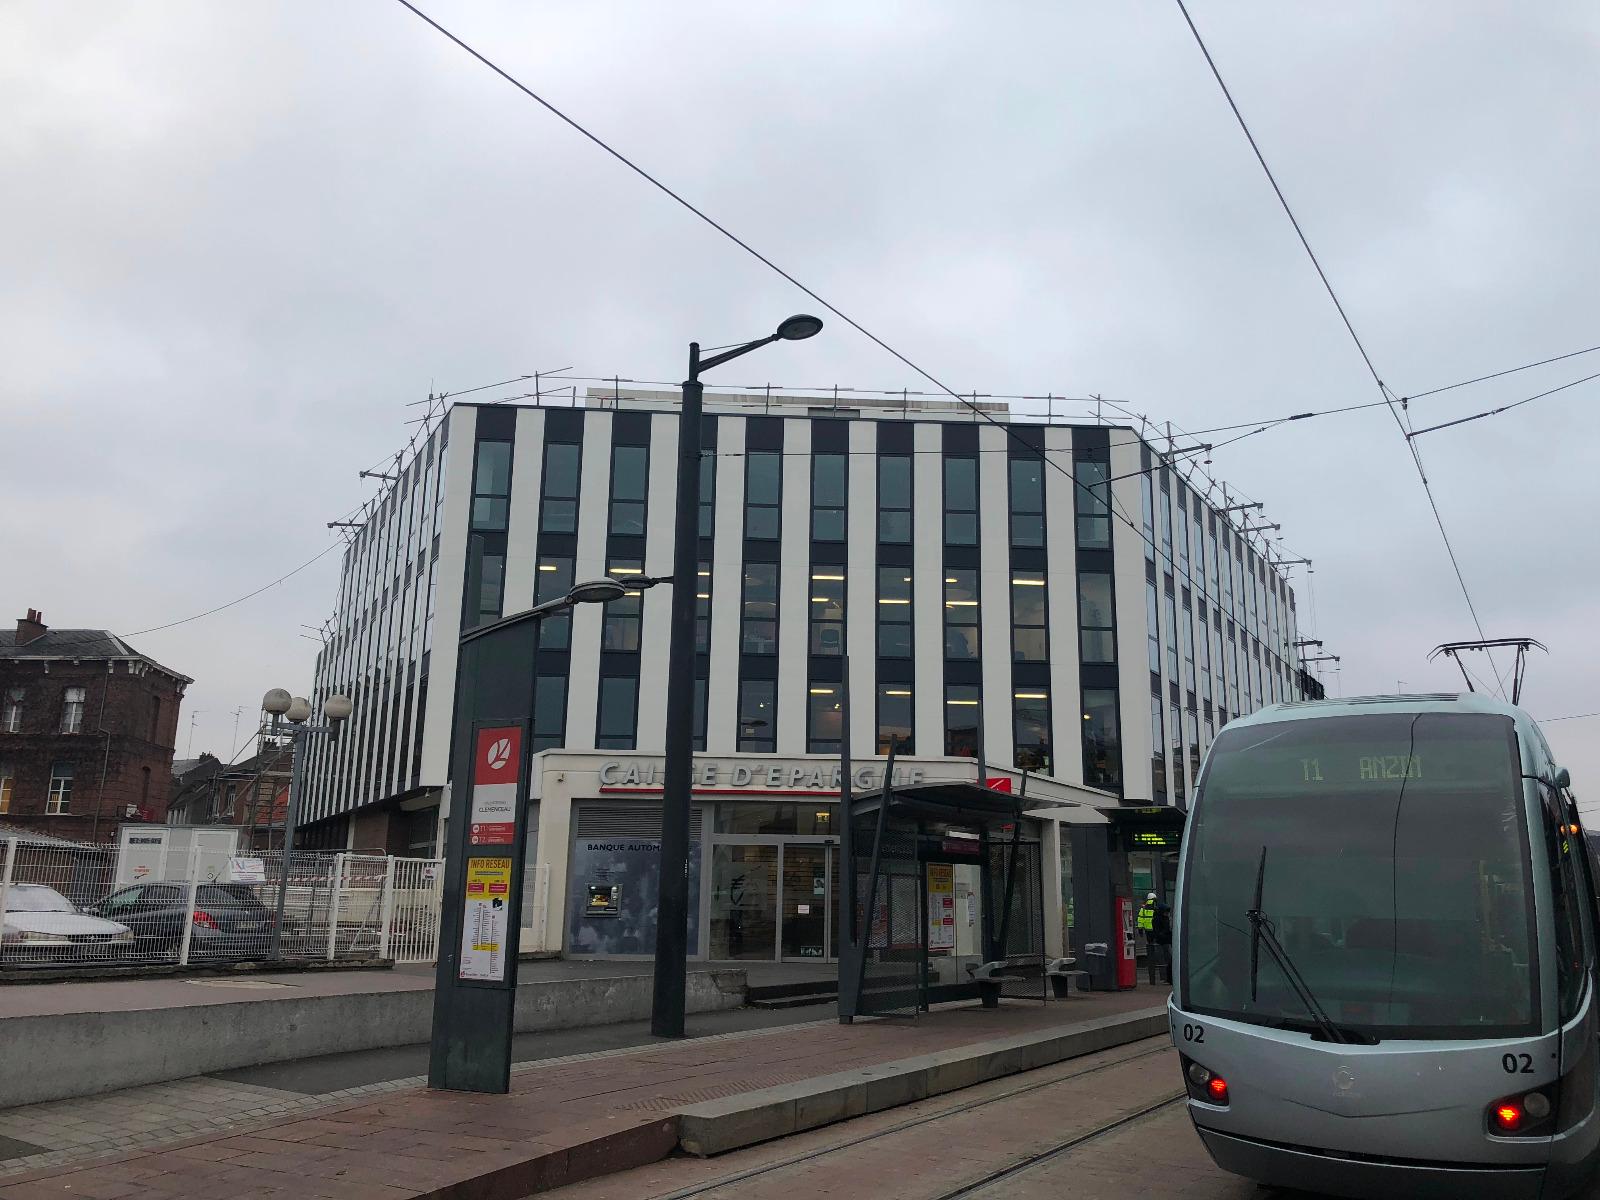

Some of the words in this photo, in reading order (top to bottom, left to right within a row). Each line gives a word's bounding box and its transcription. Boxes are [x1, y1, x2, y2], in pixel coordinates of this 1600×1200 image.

[598, 761, 718, 785] CAIE
[1299, 758, 1324, 781] T1
[1360, 755, 1422, 779] ANZIN
[587, 843, 625, 852] BANQUE
[627, 843, 662, 852] AUTOM
[470, 859, 485, 869] INFO
[486, 859, 510, 869] RESEAU
[1183, 1023, 1204, 1043] 02
[1501, 1053, 1535, 1073] 02
